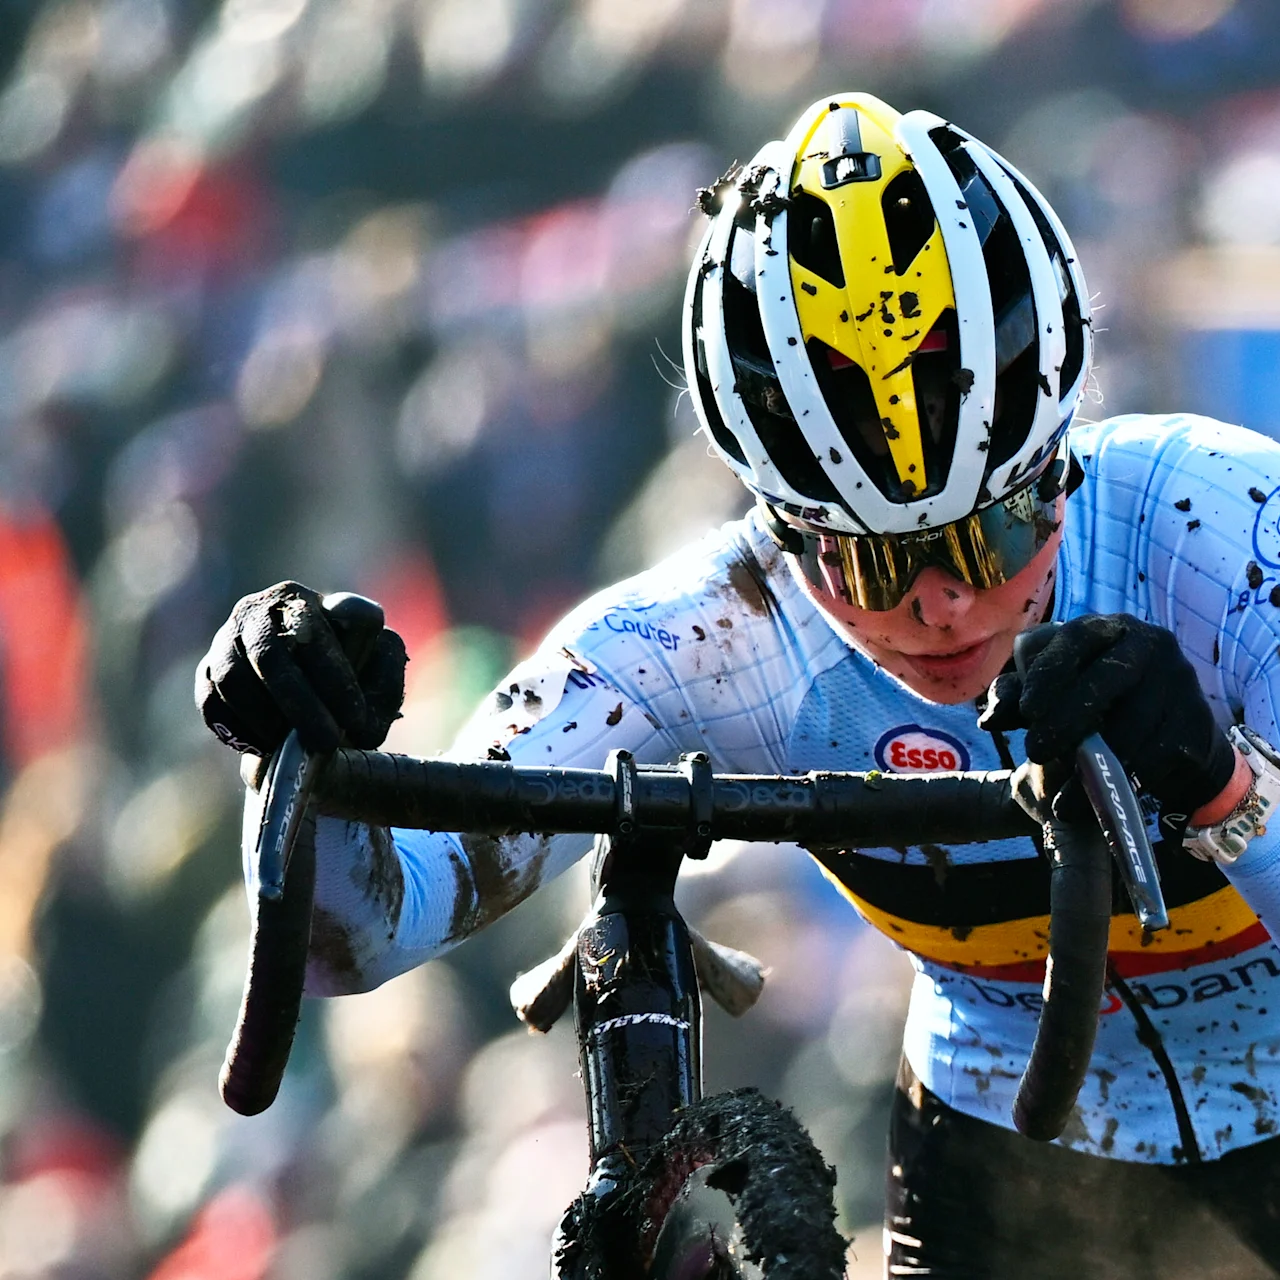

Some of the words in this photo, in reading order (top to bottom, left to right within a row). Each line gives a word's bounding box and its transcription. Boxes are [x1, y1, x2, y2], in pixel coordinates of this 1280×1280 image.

[603, 613, 681, 651] Couter
[890, 741, 956, 771] Esso
[1095, 752, 1147, 884] DURA-ACE
